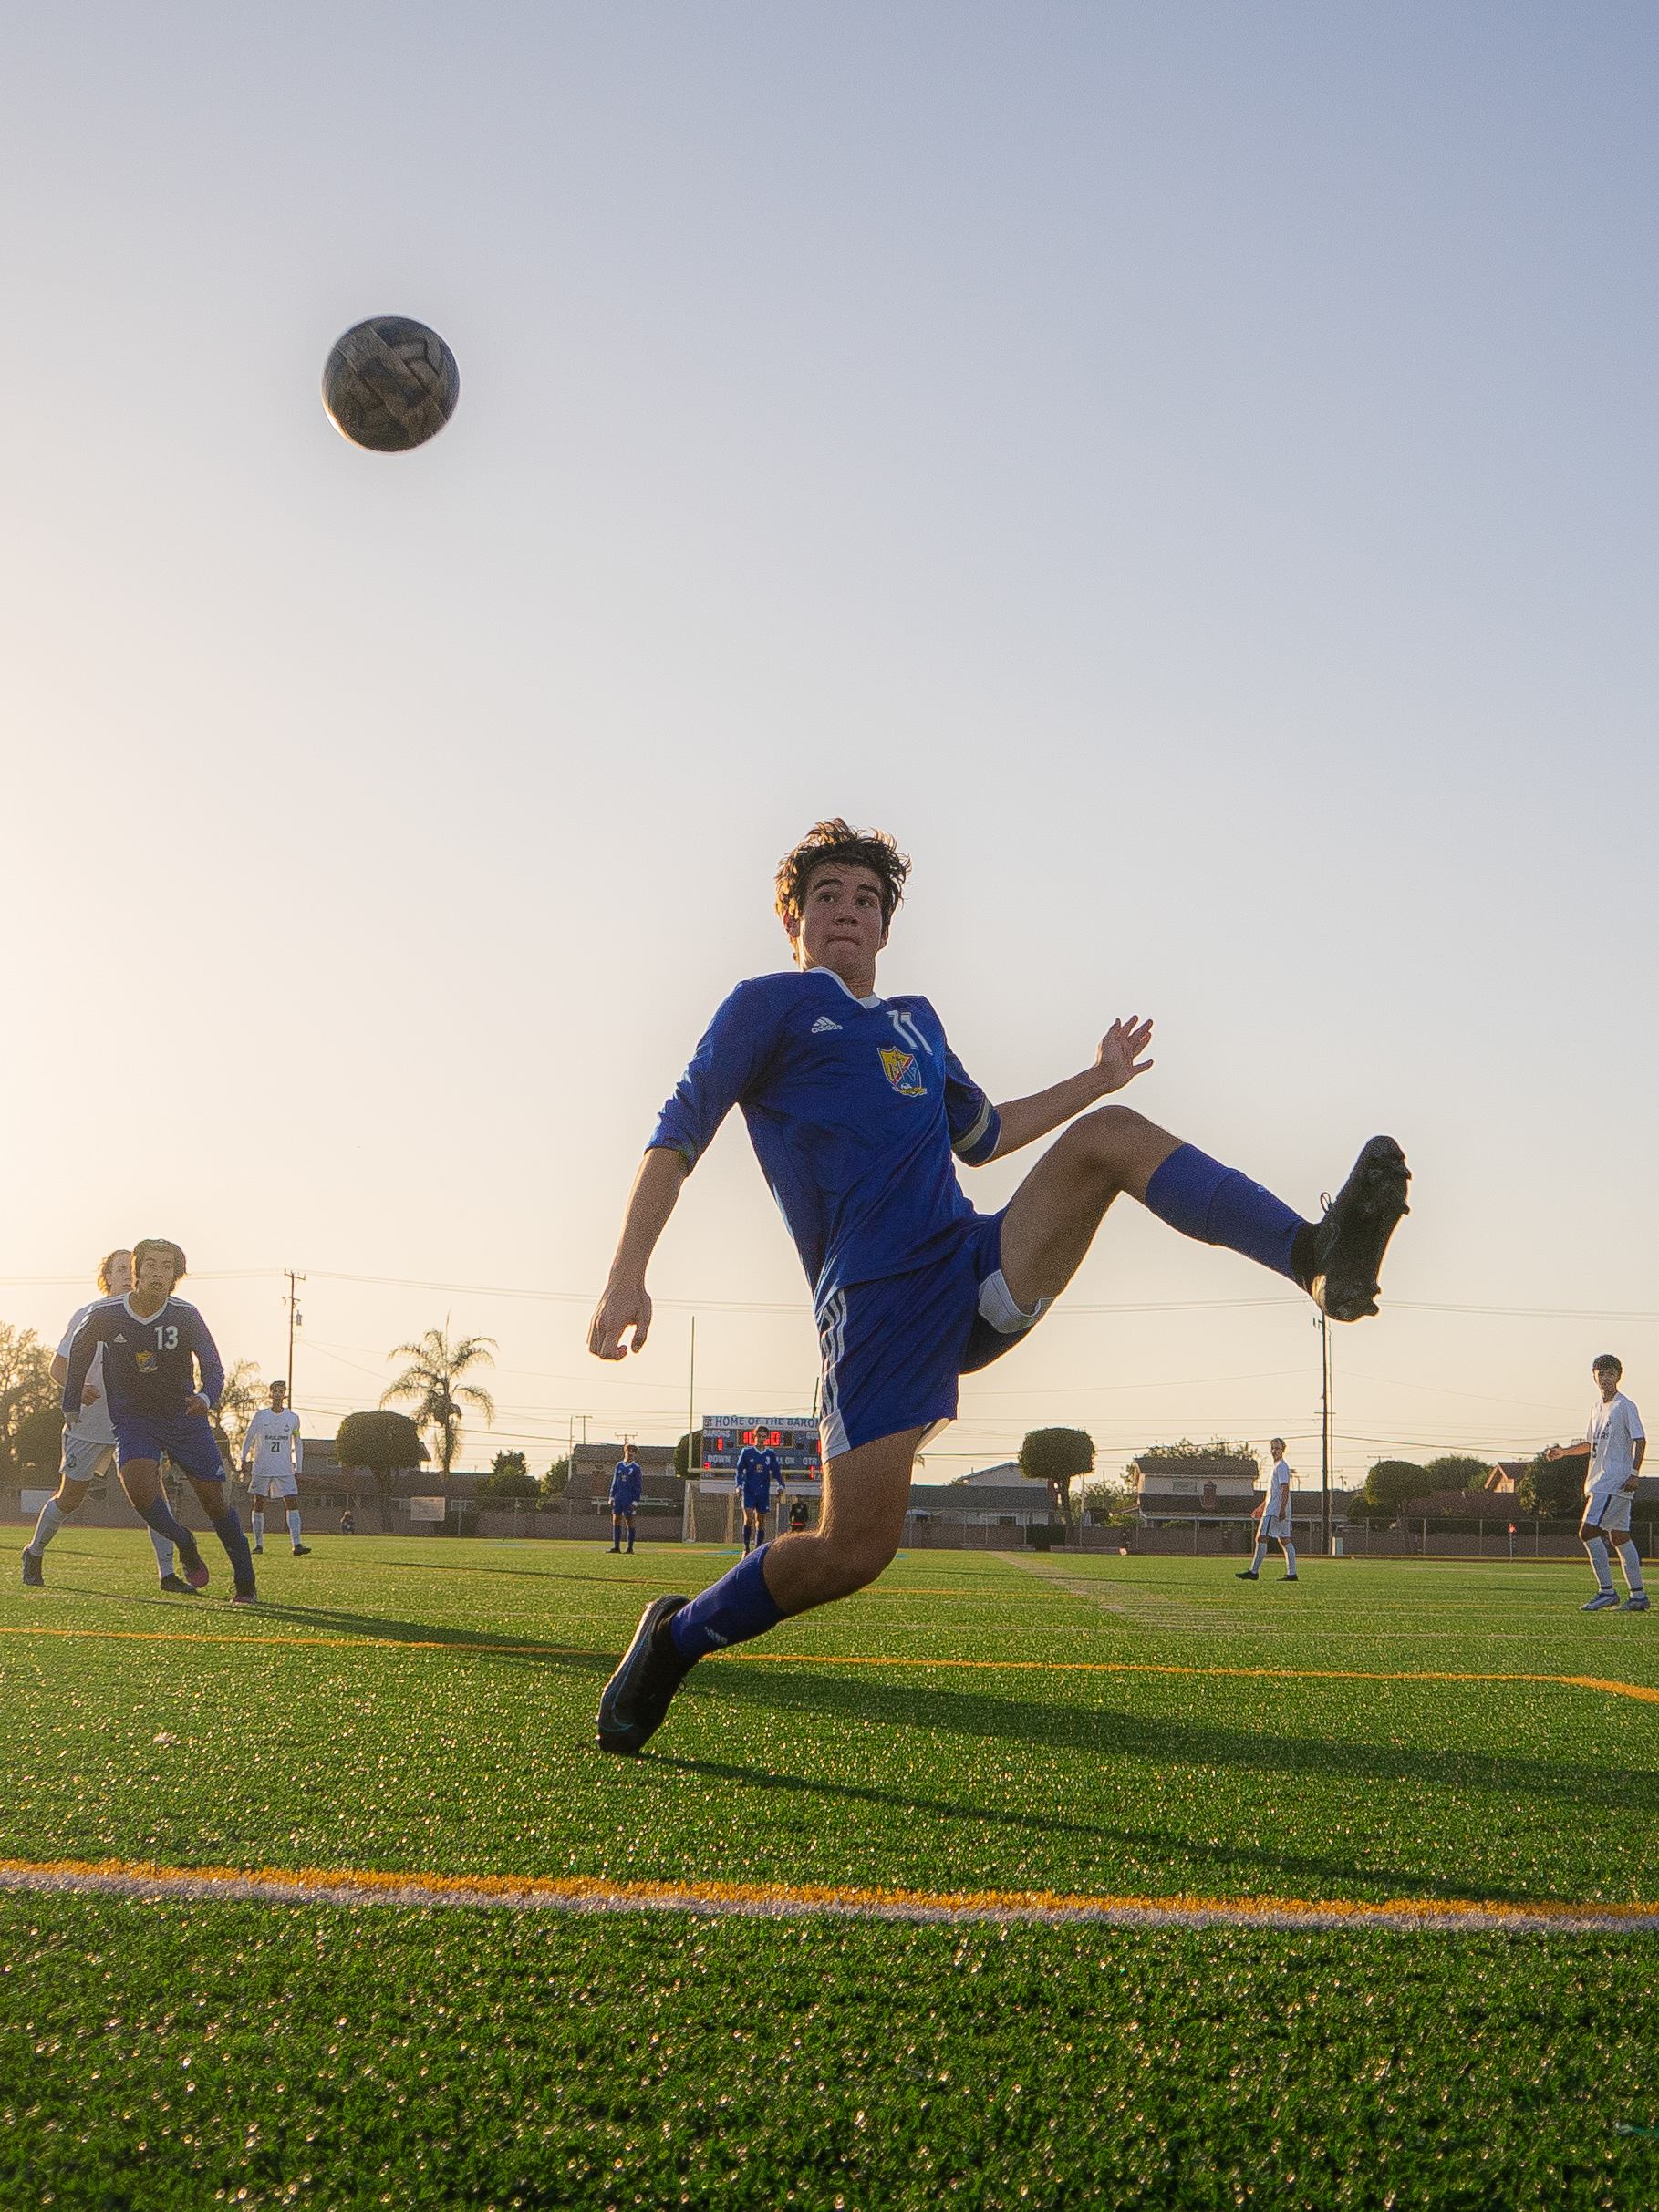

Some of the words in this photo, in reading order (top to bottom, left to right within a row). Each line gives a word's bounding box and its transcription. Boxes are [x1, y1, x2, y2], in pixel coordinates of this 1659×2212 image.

[811, 1024, 844, 1033] adidas
[887, 1010, 933, 1055] 11
[154, 1326, 178, 1349] 13
[715, 1416, 744, 1427] HOME
[748, 1417, 761, 1426] OF
[765, 1418, 783, 1426] THE
[271, 1441, 280, 1452] 21
[708, 1455, 731, 1463] DOWN
[765, 1456, 771, 1465] 3
[803, 1456, 817, 1465] QTR
